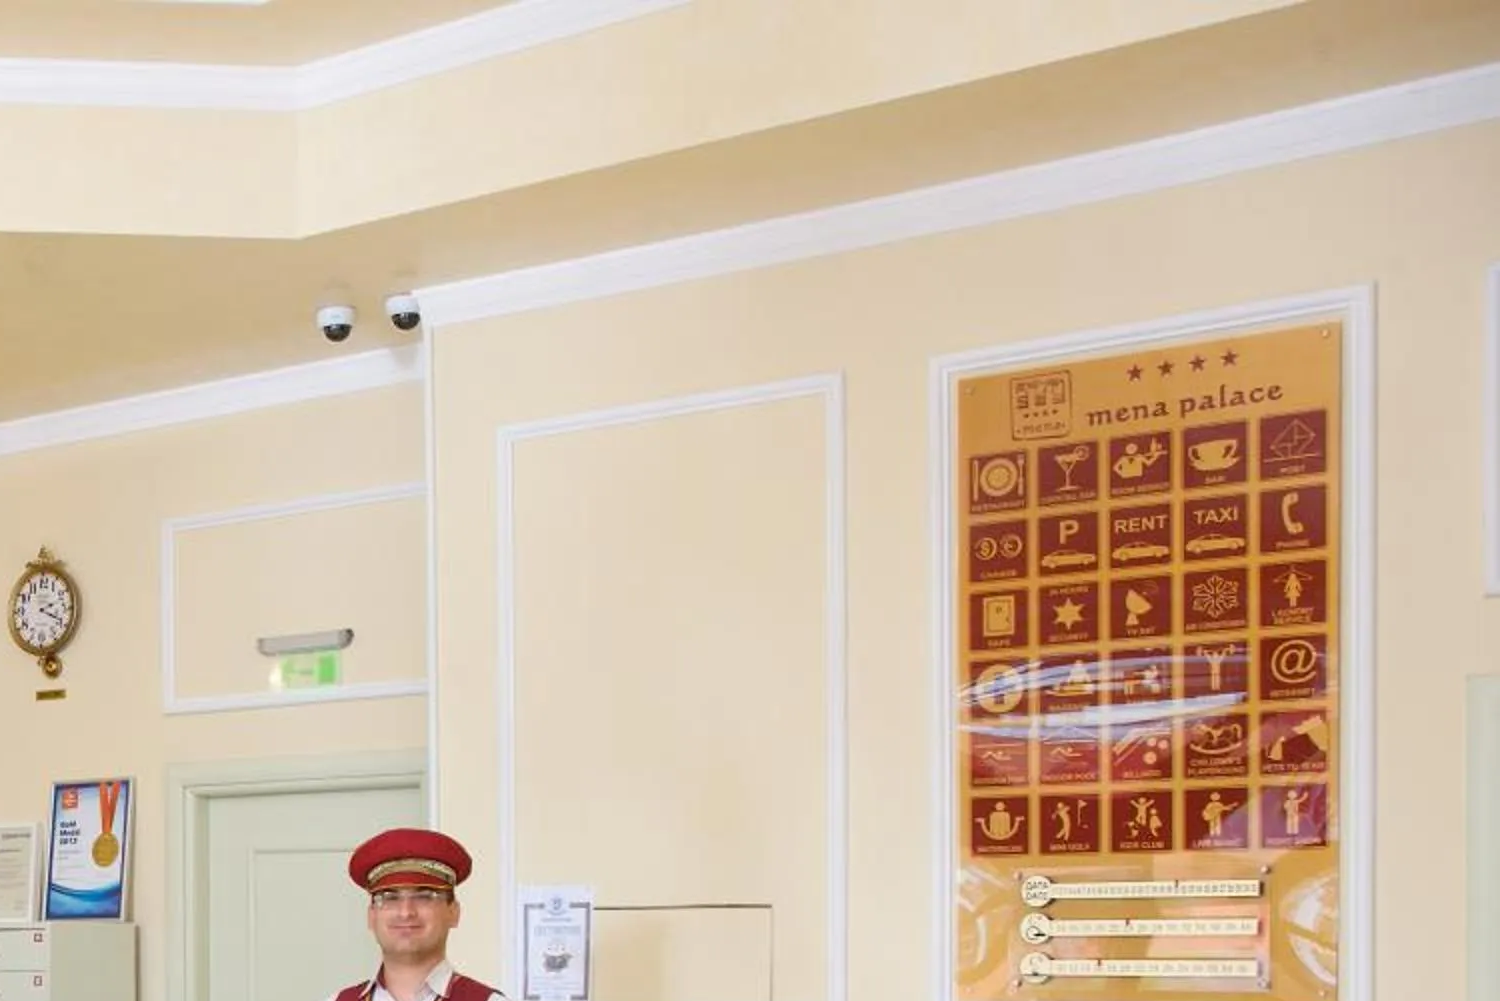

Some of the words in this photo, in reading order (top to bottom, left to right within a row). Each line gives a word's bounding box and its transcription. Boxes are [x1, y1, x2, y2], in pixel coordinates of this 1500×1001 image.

[1087, 401, 1170, 426] mena
[1180, 384, 1284, 418] palace
[1113, 514, 1168, 534] RENT
[1193, 506, 1239, 524] TAXI
[1059, 519, 1079, 544] P
